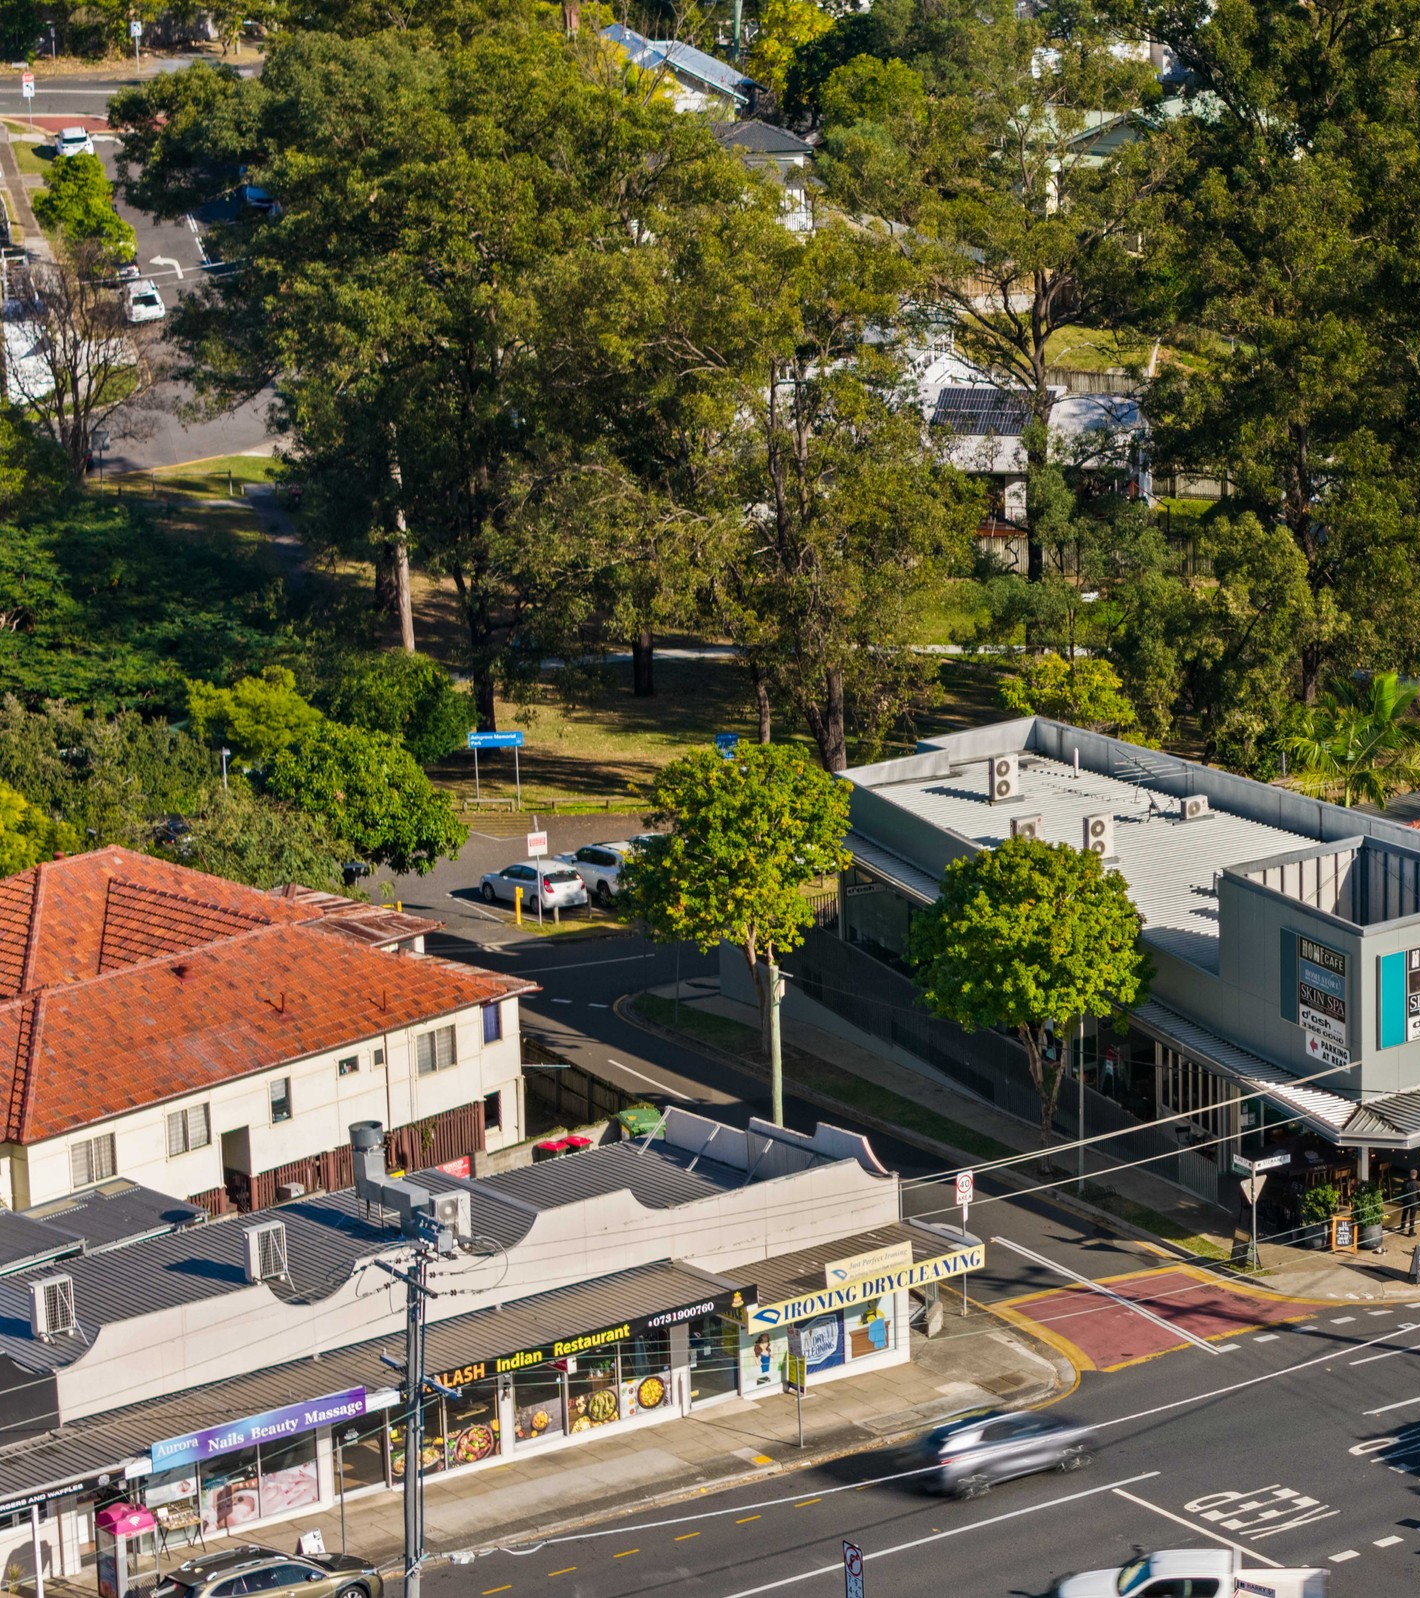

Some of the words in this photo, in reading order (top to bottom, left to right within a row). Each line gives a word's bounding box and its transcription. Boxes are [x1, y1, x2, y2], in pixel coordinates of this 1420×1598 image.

[1301, 984, 1325, 1005] SKIN
[1328, 996, 1345, 1015] SPA
[1321, 1040, 1348, 1060] PARKING
[1323, 1051, 1330, 1061] AT
[960, 1179, 970, 1188] 40
[885, 1249, 907, 1260] Ironing
[784, 1286, 857, 1322] IRONING
[862, 1249, 980, 1298] DRYCLEANING
[653, 1302, 714, 1326] 0731900760
[496, 1351, 543, 1372] Indian
[554, 1323, 630, 1357] Restaurant
[156, 1437, 198, 1457] Aurora
[207, 1432, 244, 1452] Nails
[251, 1418, 298, 1440] Beauty
[304, 1399, 363, 1425] Massage
[28, 1494, 46, 1504] AND
[47, 1483, 84, 1498] WAFFLES
[1184, 1484, 1341, 1540] KEEP
